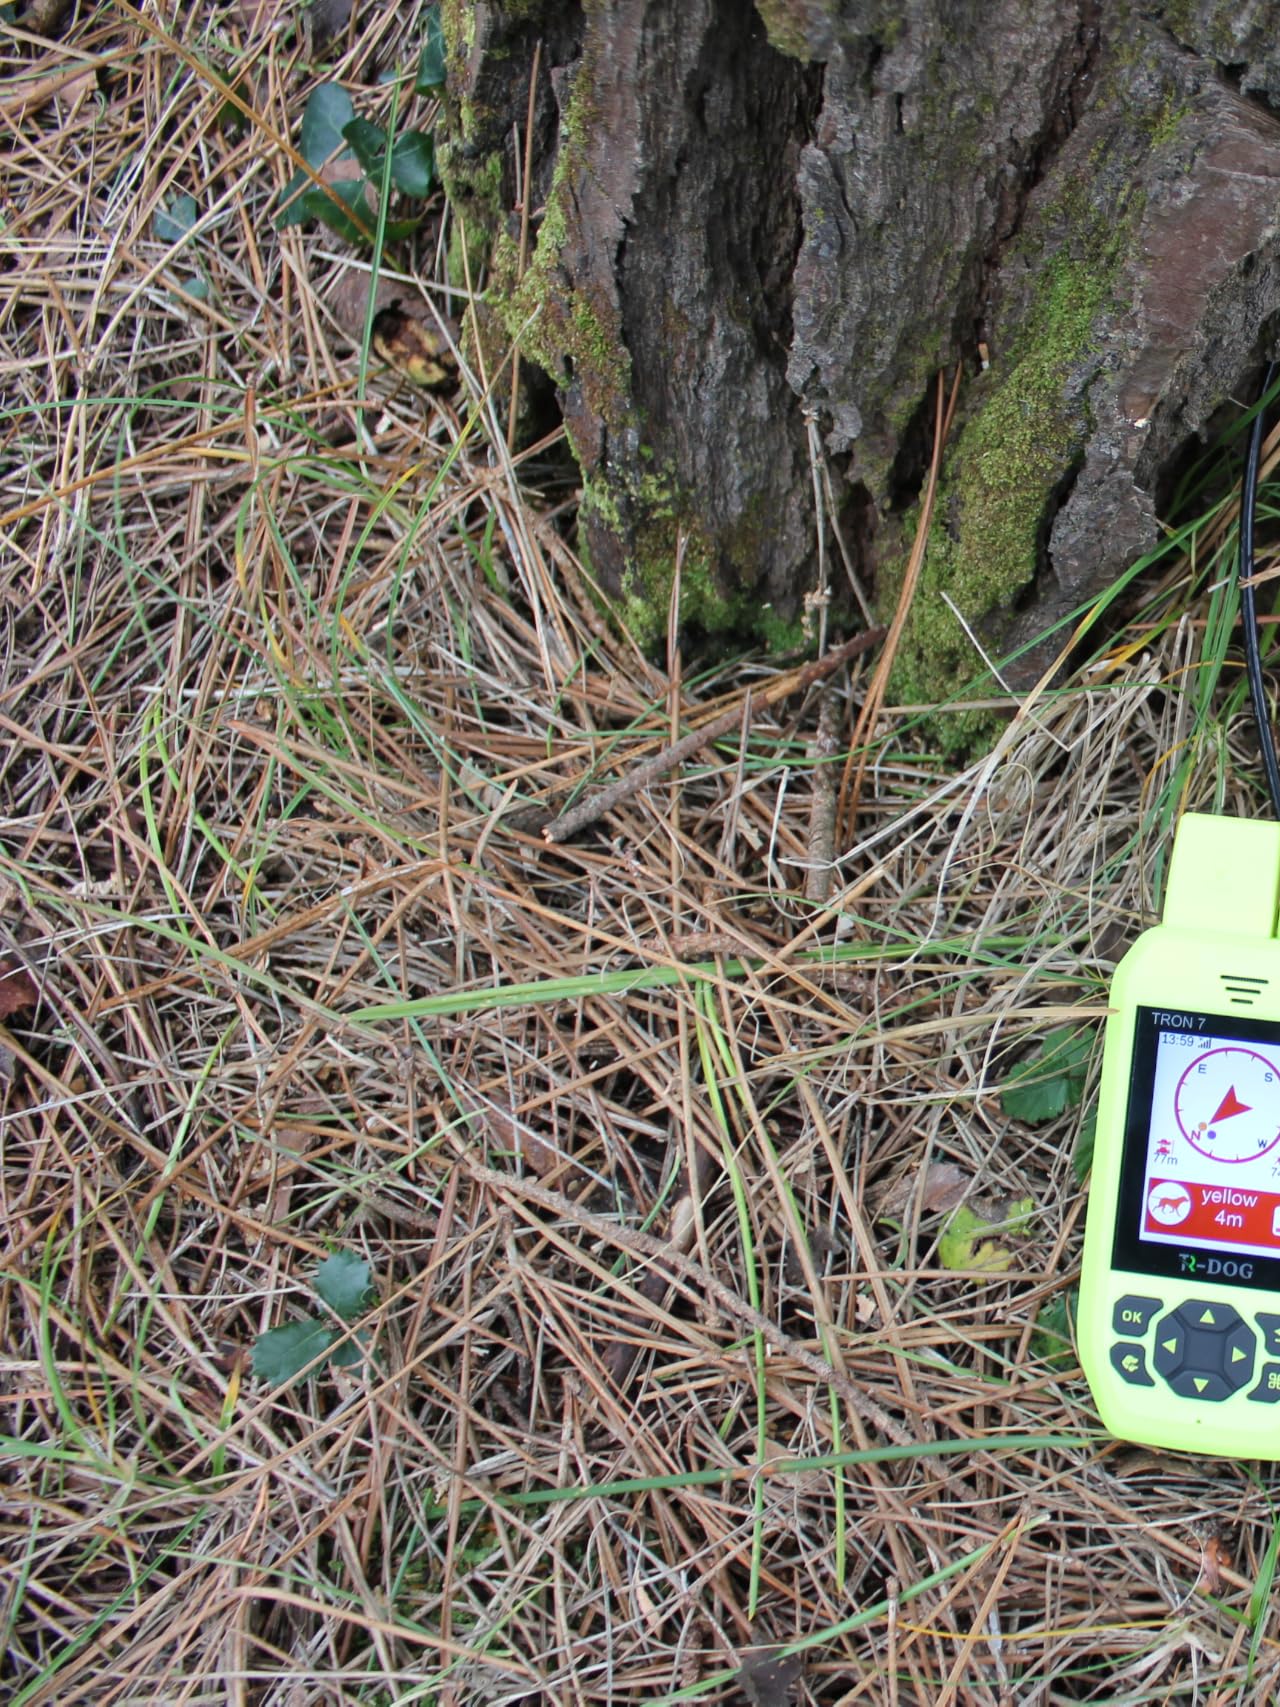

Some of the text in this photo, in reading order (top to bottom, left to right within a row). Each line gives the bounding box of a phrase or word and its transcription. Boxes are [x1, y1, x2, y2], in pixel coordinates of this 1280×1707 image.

[1152, 1012, 1206, 1031] TRON 7
[1162, 1033, 1194, 1047] 13:59
[1198, 1064, 1207, 1074] E
[1264, 1072, 1273, 1082] S
[1191, 1130, 1201, 1141] N
[1257, 1138, 1268, 1149] W
[1201, 1188, 1259, 1208] yellow
[1214, 1210, 1243, 1228] 4m
[1122, 1309, 1142, 1324] OK
